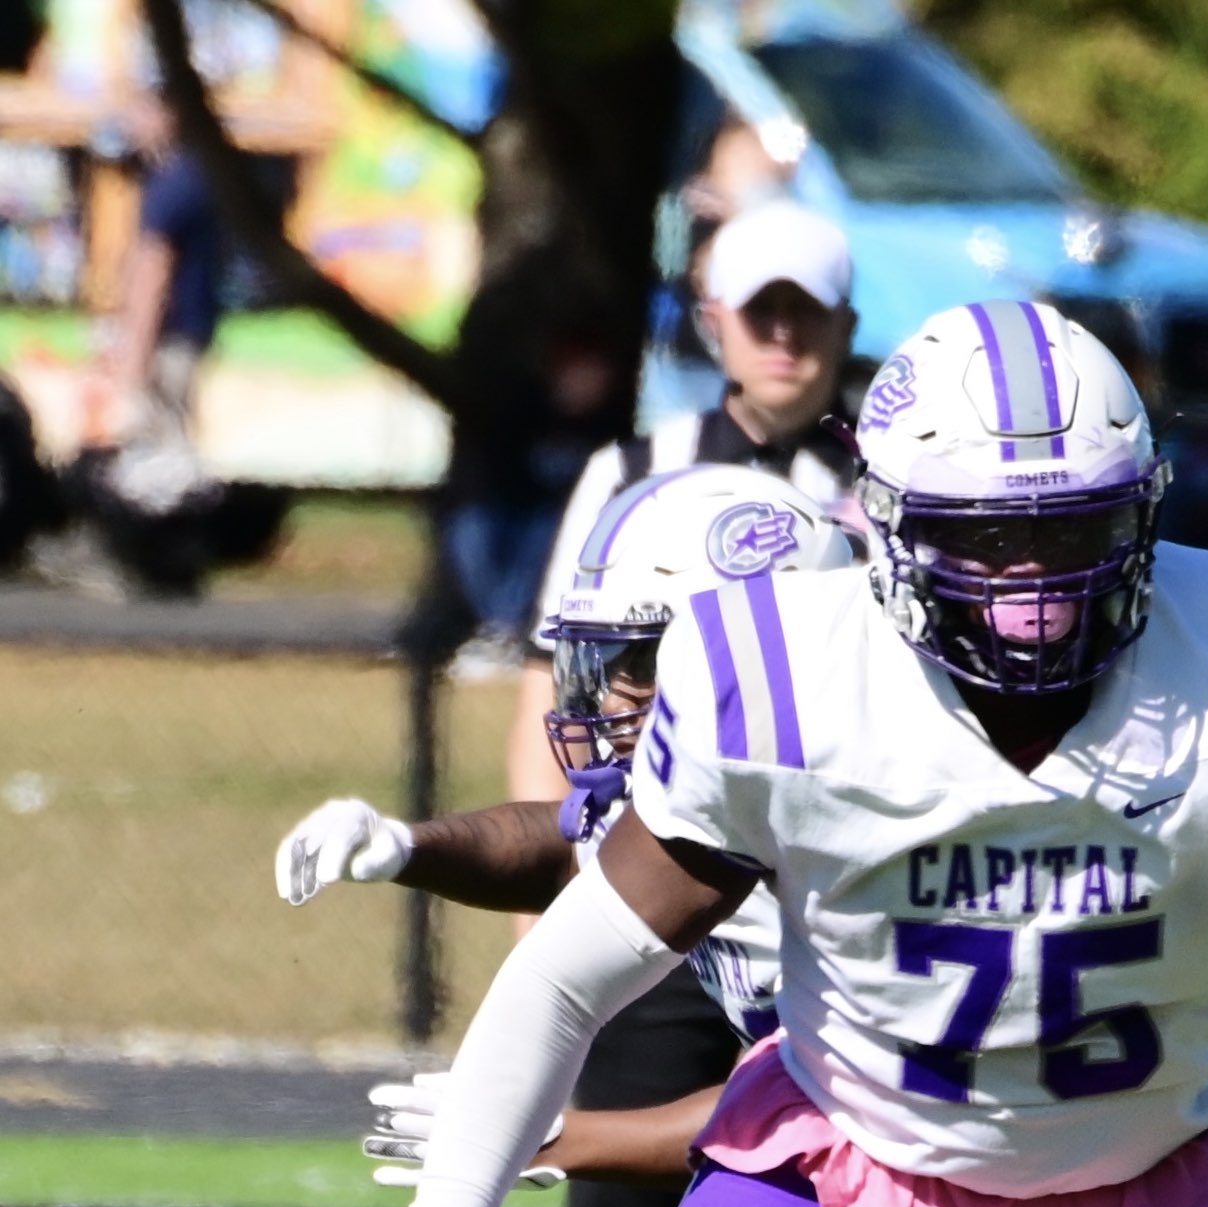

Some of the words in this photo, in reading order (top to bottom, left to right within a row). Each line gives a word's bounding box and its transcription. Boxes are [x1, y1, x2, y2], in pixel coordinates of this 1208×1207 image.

[1005, 470, 1069, 488] COMETS
[908, 844, 1150, 914] CAPITAL
[893, 914, 1165, 1104] 75
